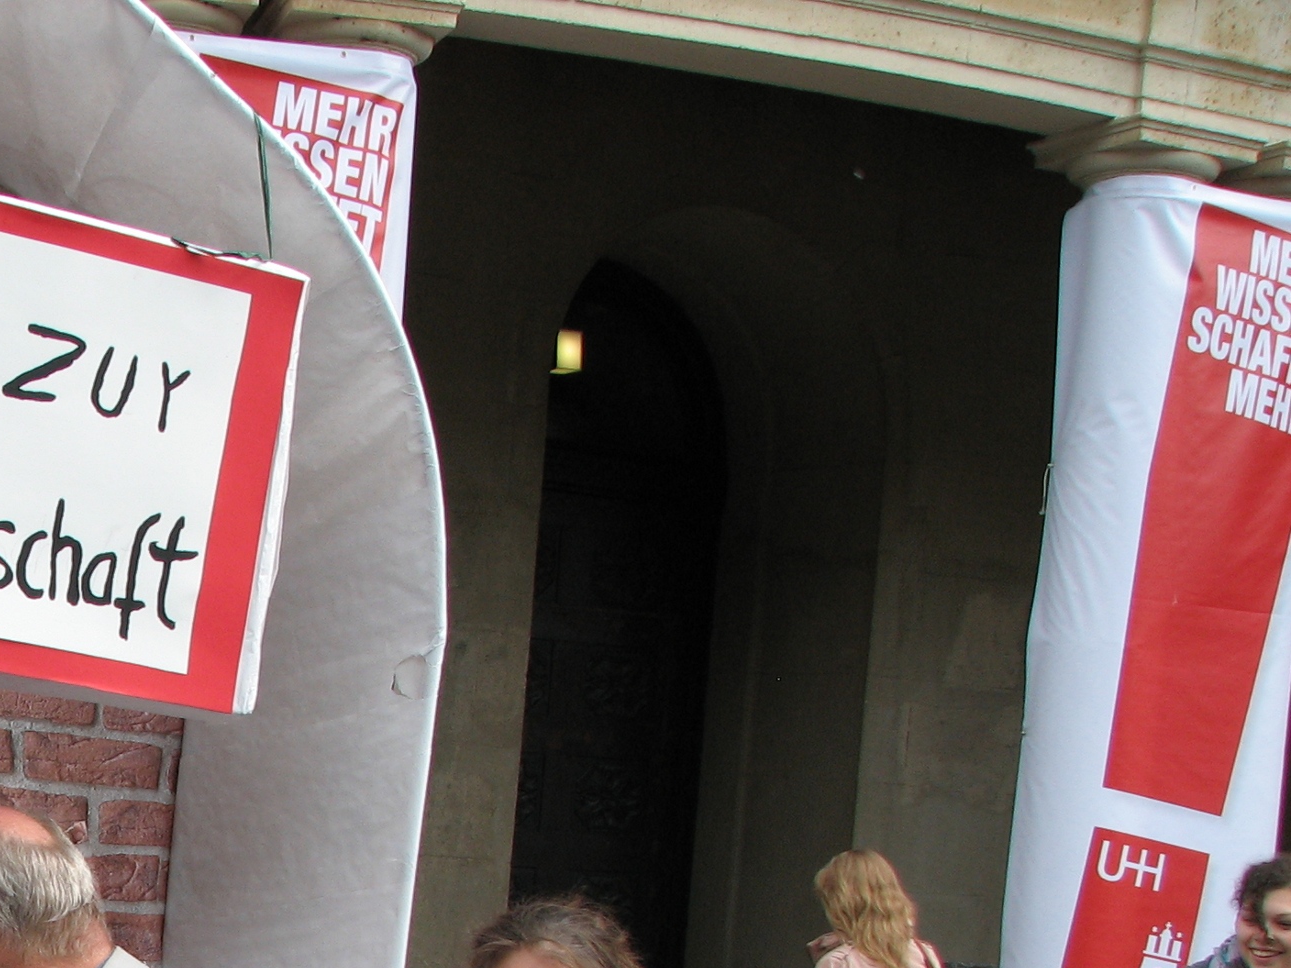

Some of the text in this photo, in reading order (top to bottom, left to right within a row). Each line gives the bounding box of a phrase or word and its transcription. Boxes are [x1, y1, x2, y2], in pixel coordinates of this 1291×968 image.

[272, 81, 397, 157] MEHR
[272, 129, 389, 207] SEN
[1187, 306, 1291, 385] SCHAF
[1225, 368, 1291, 435] MEH
